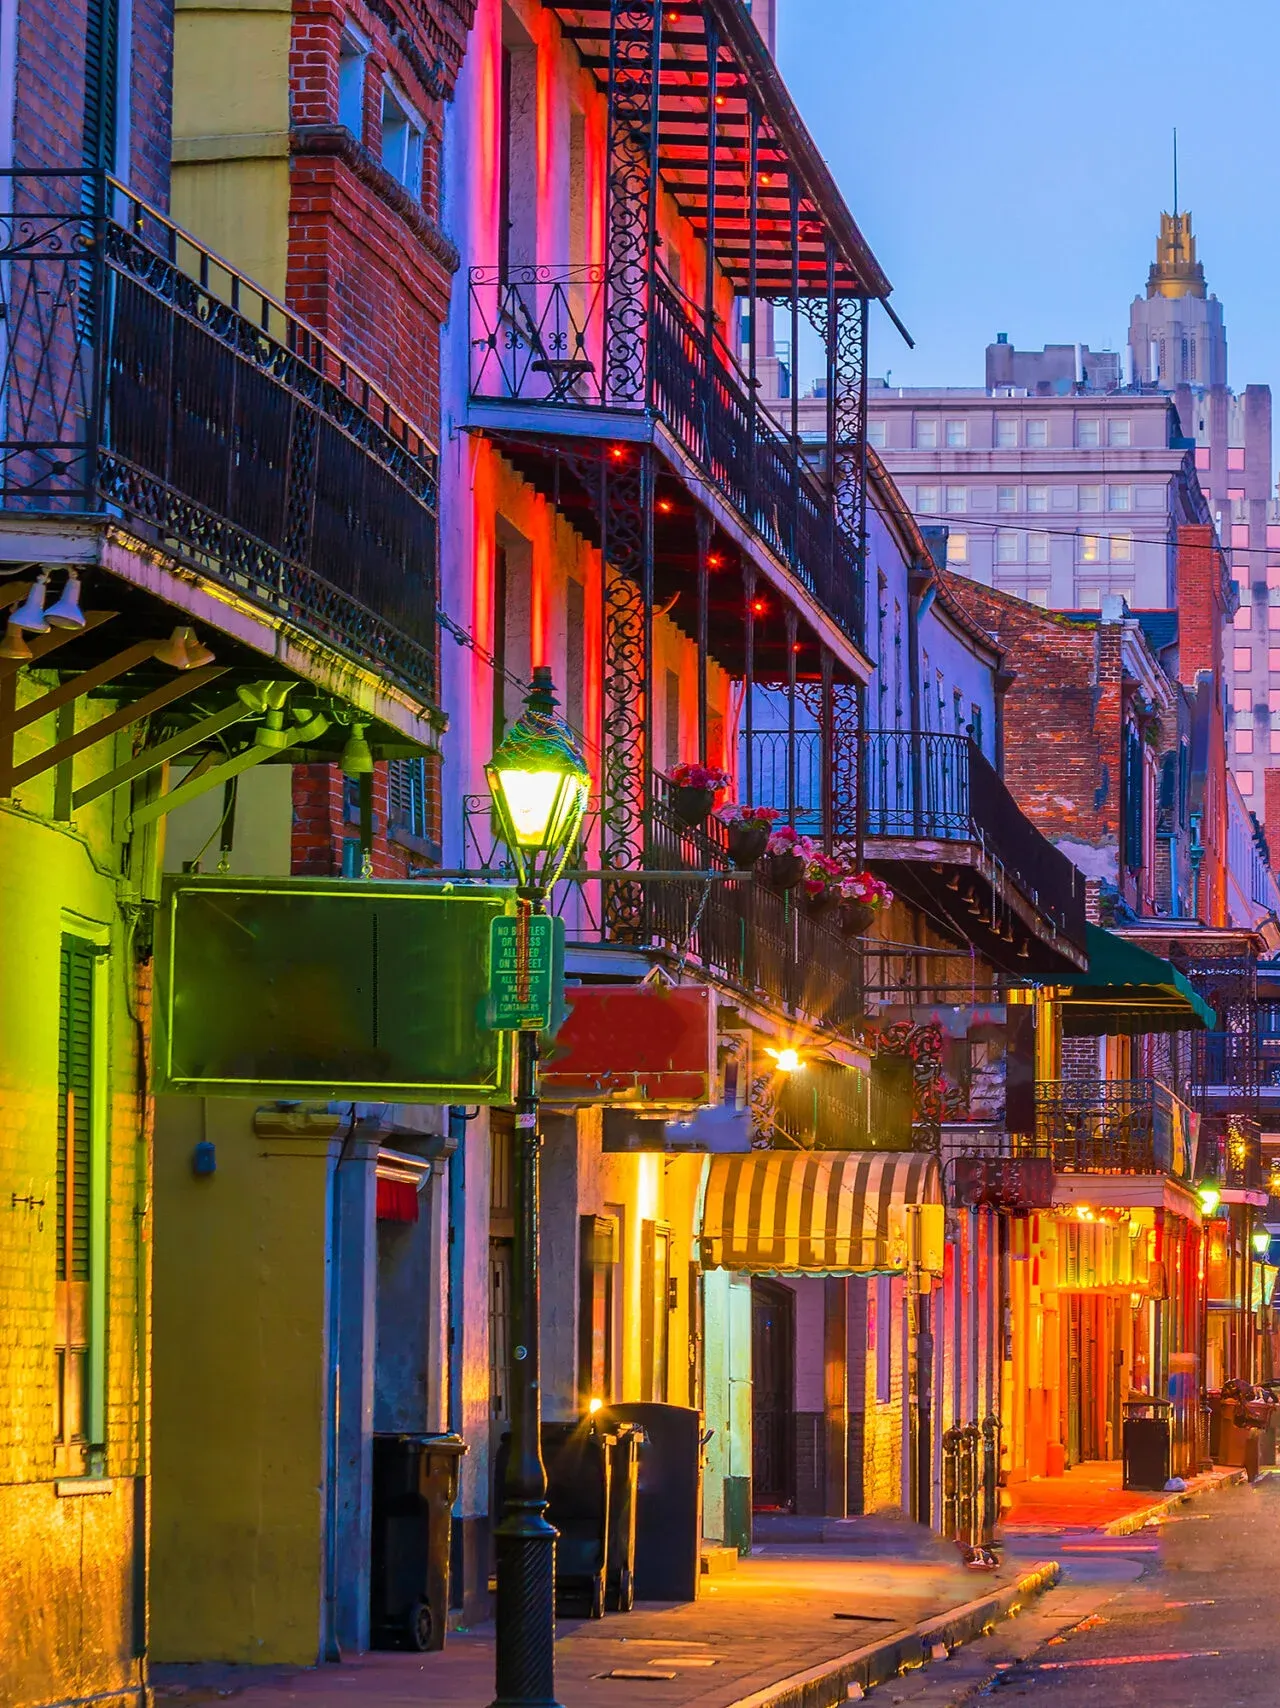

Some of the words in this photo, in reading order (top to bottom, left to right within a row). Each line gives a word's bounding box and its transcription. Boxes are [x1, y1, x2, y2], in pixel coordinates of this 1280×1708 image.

[498, 926, 509, 936] NO
[511, 926, 546, 936] BLES
[501, 937, 513, 947] OR
[503, 947, 540, 958] ALLED
[499, 958, 510, 969] ON
[513, 958, 543, 969] SEET
